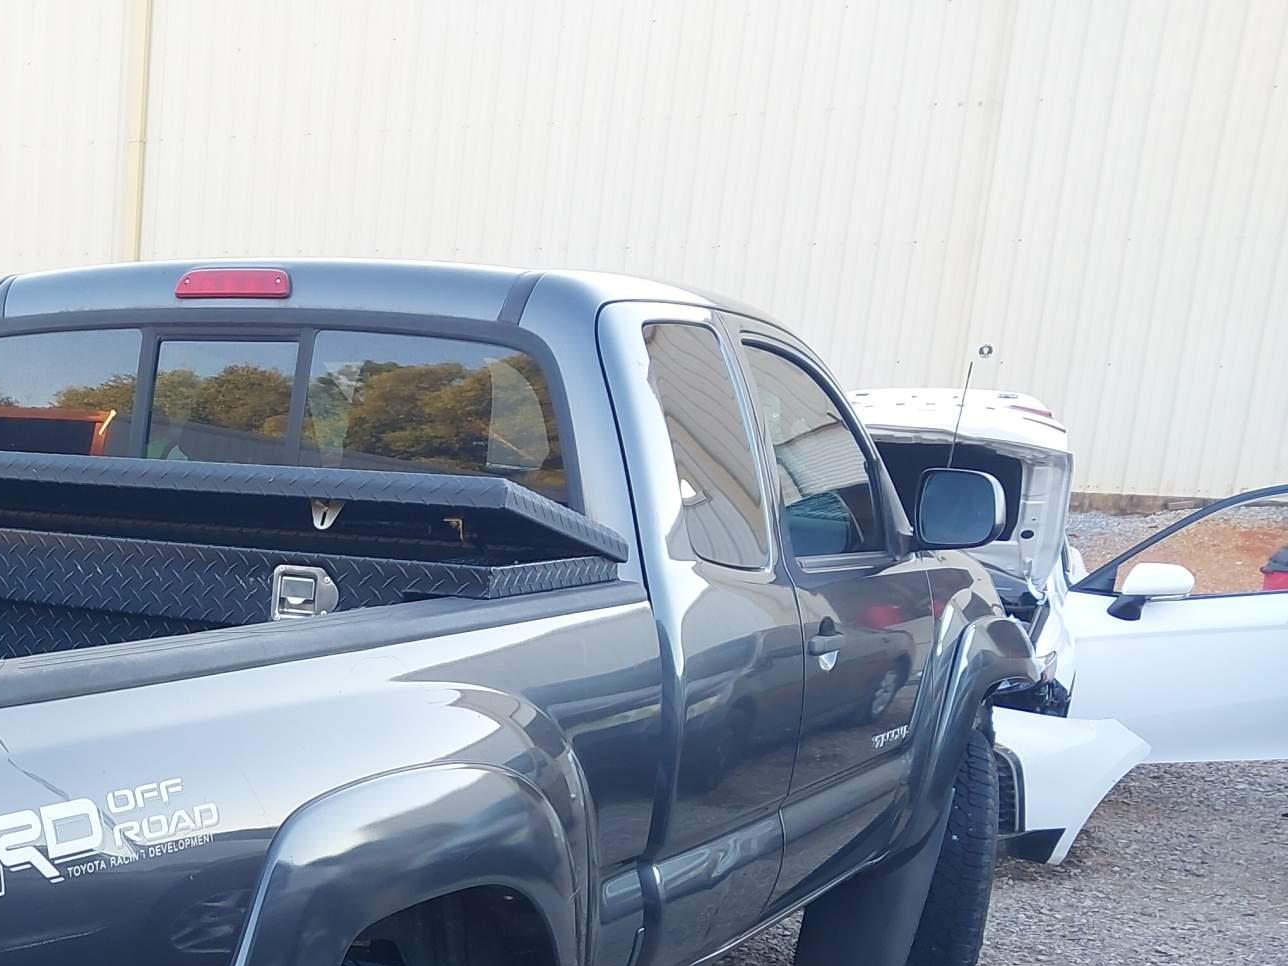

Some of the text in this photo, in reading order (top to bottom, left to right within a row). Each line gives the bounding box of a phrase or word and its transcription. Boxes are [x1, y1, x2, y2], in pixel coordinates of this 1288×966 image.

[107, 777, 184, 813] OFF
[114, 802, 219, 846] ROAD
[66, 860, 107, 879] TOYOTA
[148, 832, 215, 859] DEVELOPMENT
